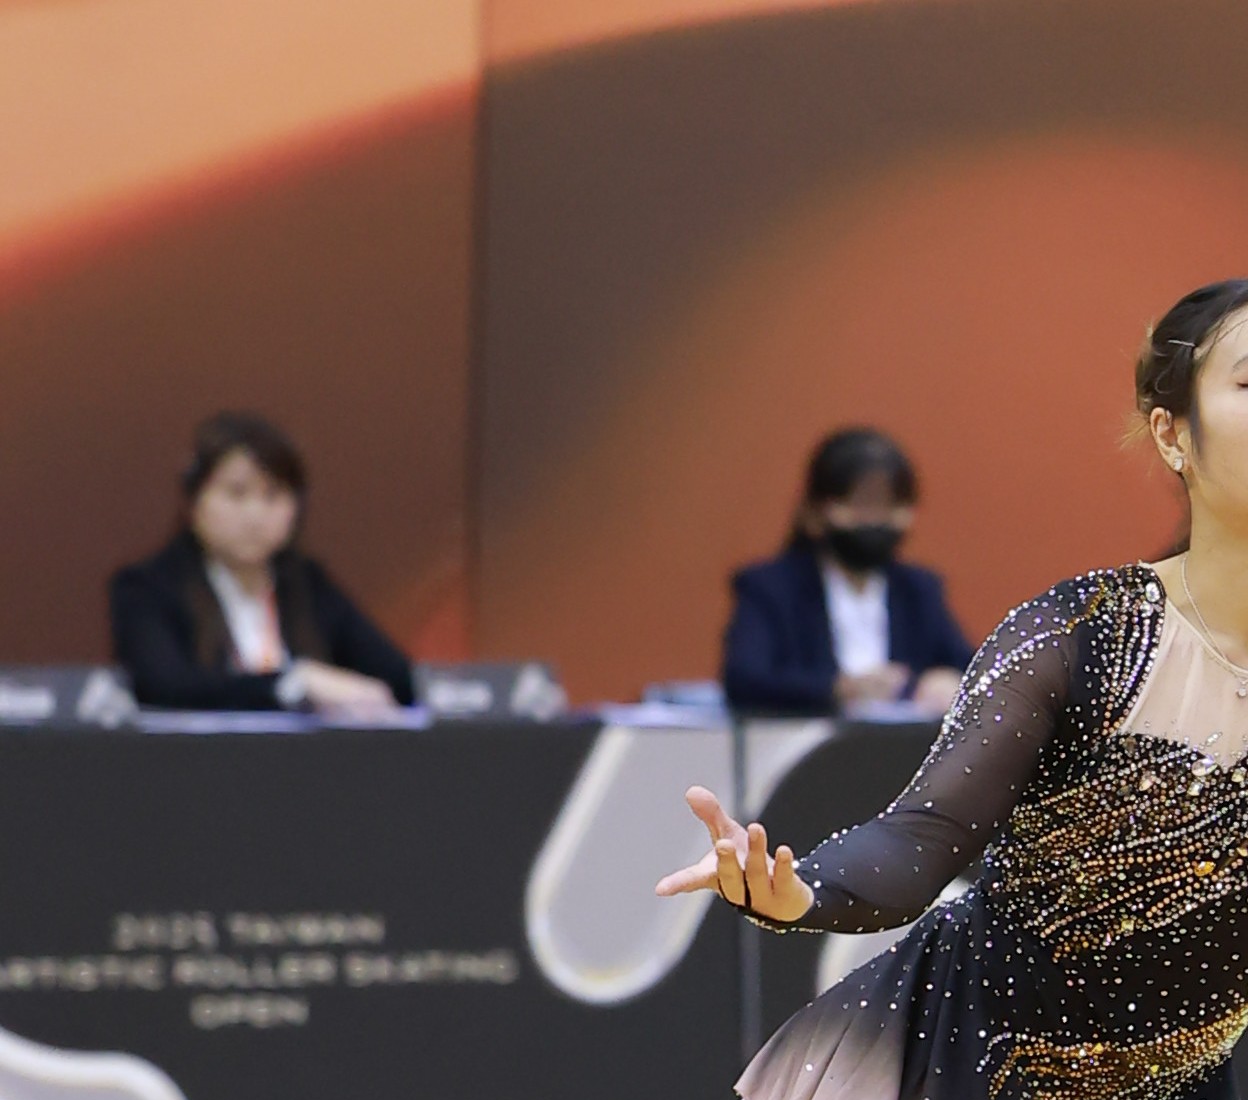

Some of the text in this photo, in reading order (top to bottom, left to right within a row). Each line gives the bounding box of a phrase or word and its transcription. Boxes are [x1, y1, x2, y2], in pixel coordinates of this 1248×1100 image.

[0, 951, 518, 990] RTISTIC ROLLER SKATING
[192, 995, 309, 1028] OPEN
